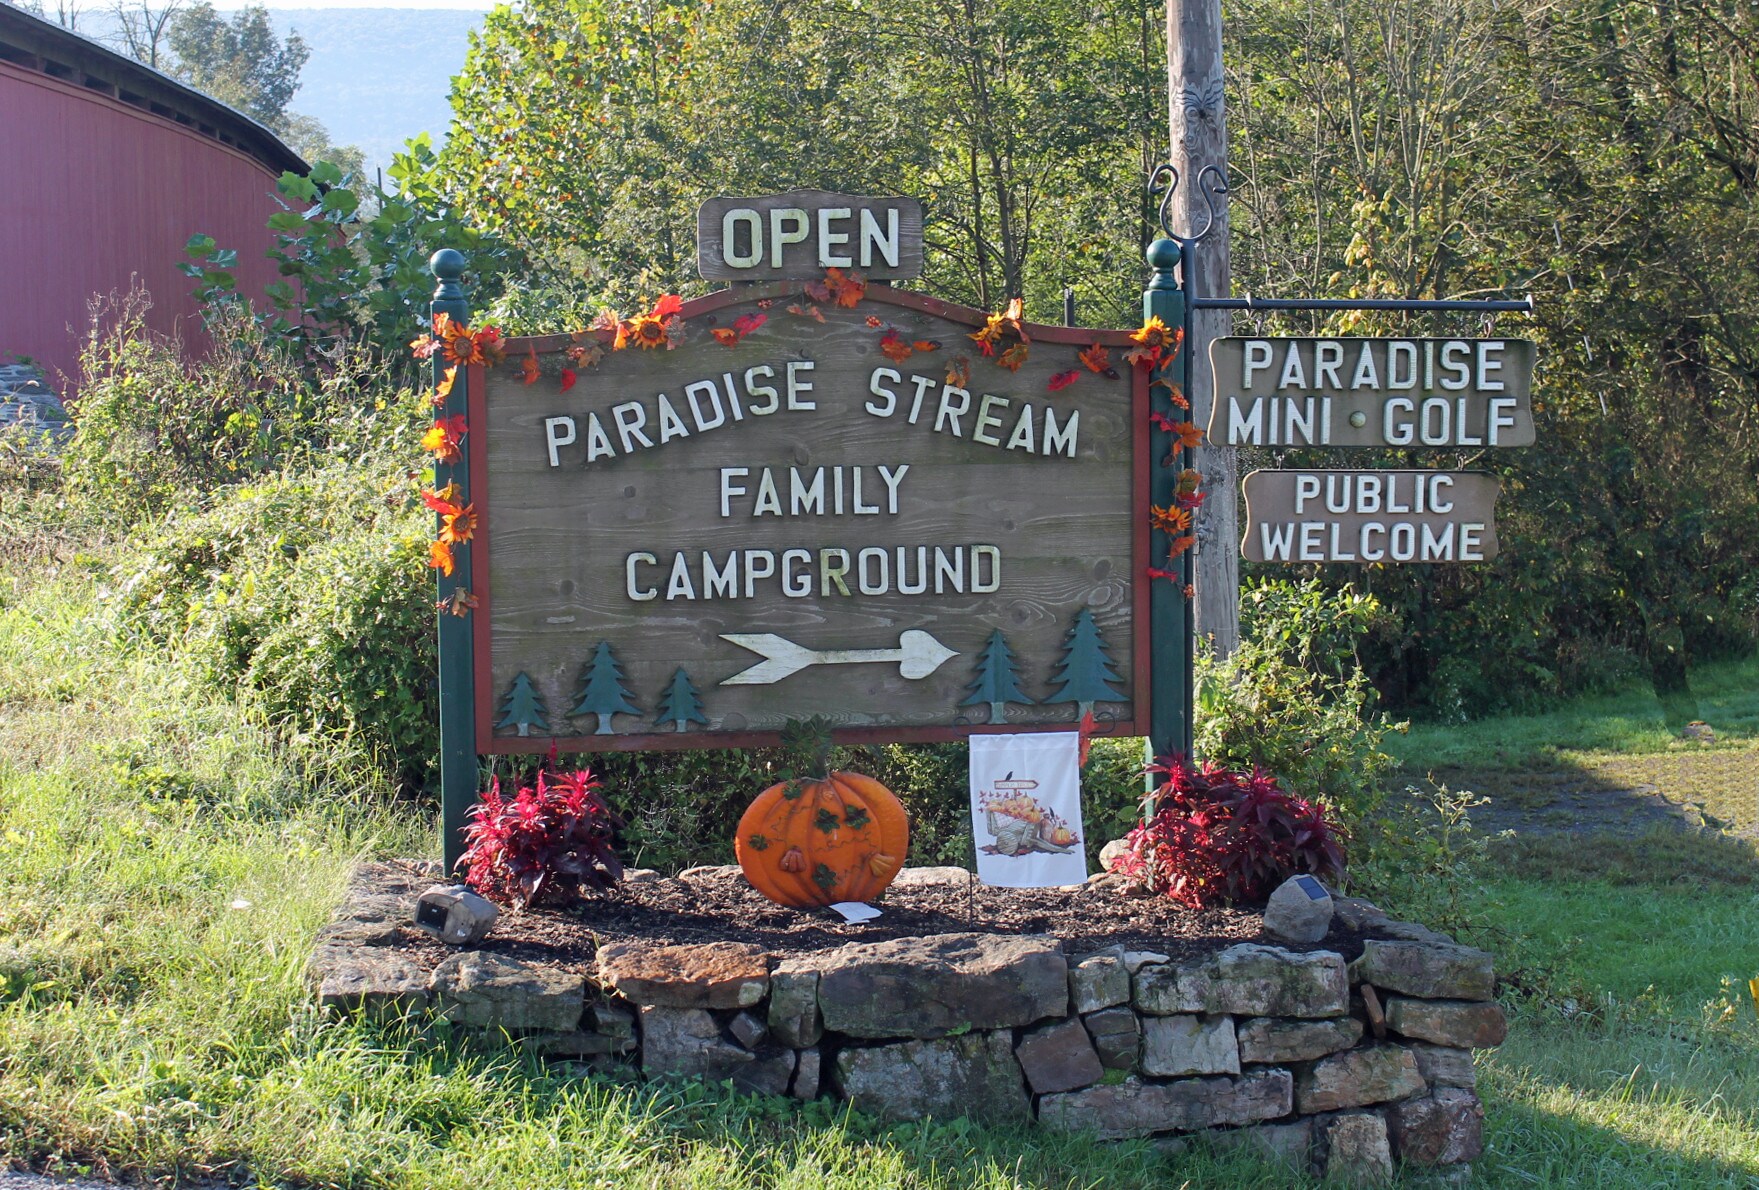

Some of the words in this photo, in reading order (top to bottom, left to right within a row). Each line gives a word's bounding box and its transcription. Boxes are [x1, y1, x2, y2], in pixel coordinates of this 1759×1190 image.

[722, 207, 900, 269] OPEN
[1243, 340, 1505, 390] PARADISE
[544, 360, 817, 467] PARADISE
[865, 367, 1080, 459] STREAM
[1228, 397, 1331, 445] MINI
[1383, 397, 1517, 446] GOLF
[720, 465, 910, 518] FAMILY
[1295, 474, 1454, 514] PUBLIC
[1260, 521, 1485, 561] WELCOME
[626, 544, 1001, 602] CAMPGROUND
